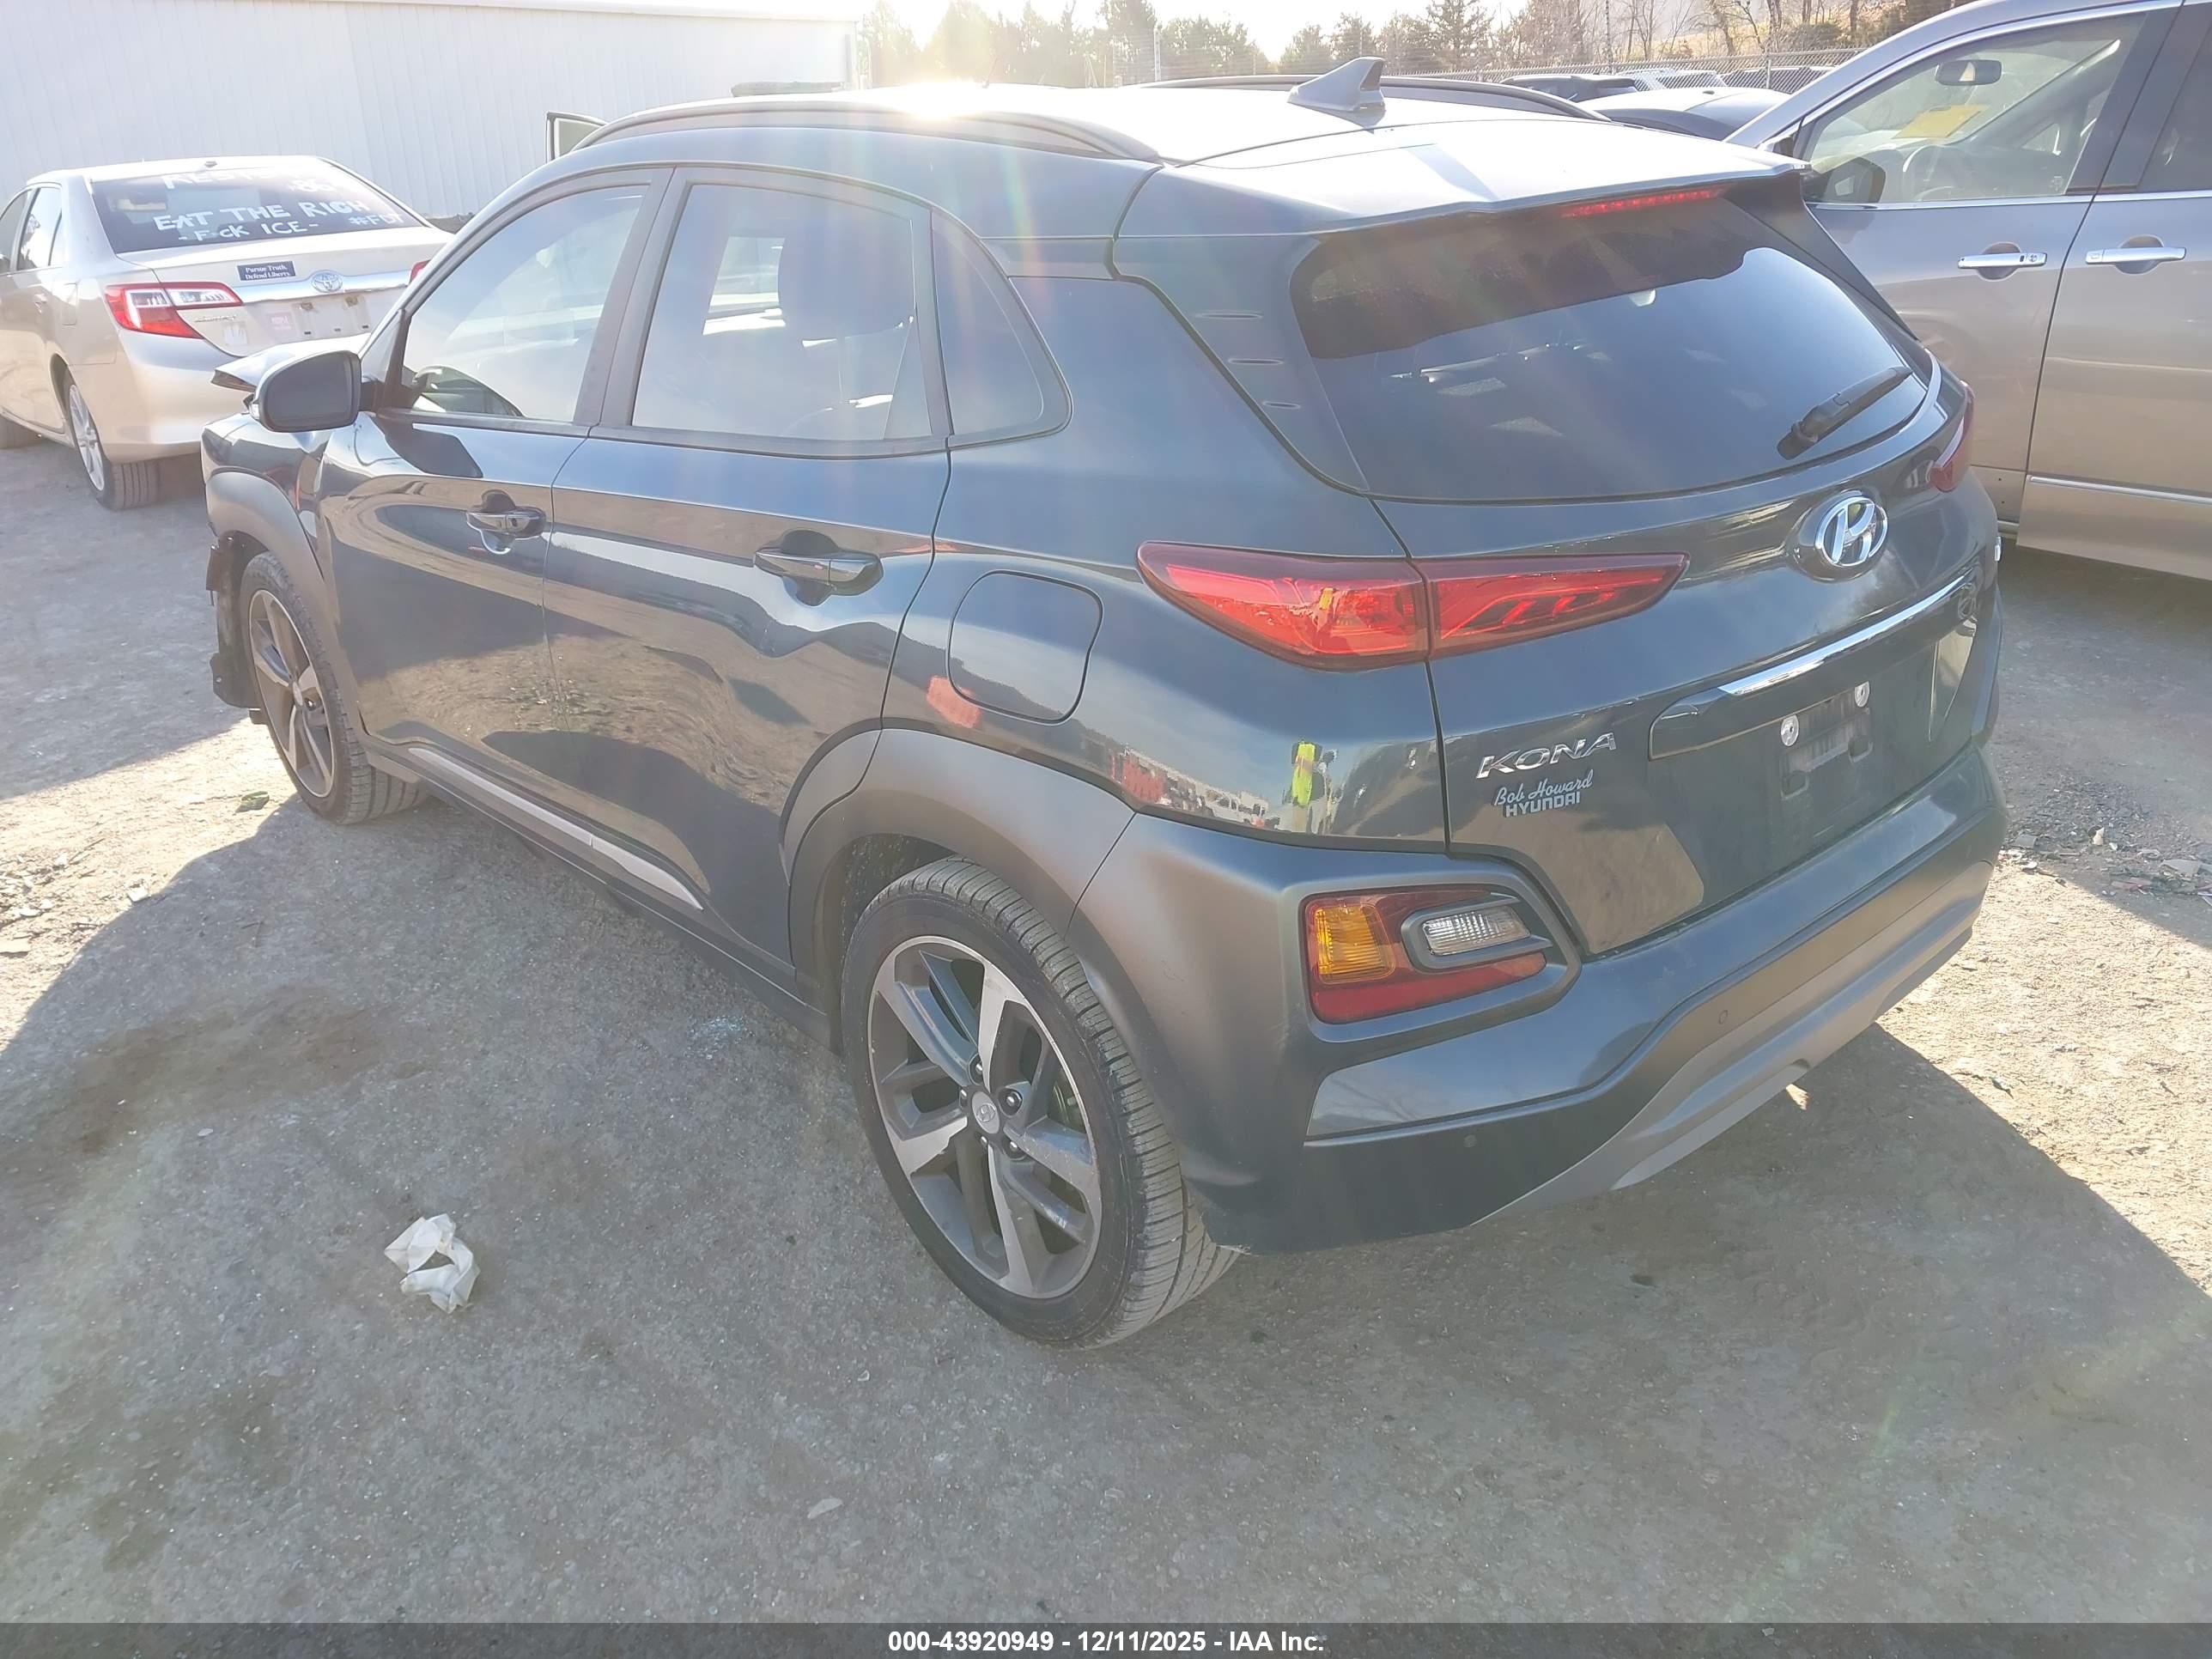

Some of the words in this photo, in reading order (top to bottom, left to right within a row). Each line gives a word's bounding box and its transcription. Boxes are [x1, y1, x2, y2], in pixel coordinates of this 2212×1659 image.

[153, 211, 213, 231] EAT
[220, 204, 290, 222] THE
[261, 221, 307, 235] ICE
[1475, 732, 1617, 779] KONA
[1494, 783, 1524, 806] Bob
[1528, 769, 1594, 799] Howard
[1505, 791, 1581, 817] HYUNDAI
